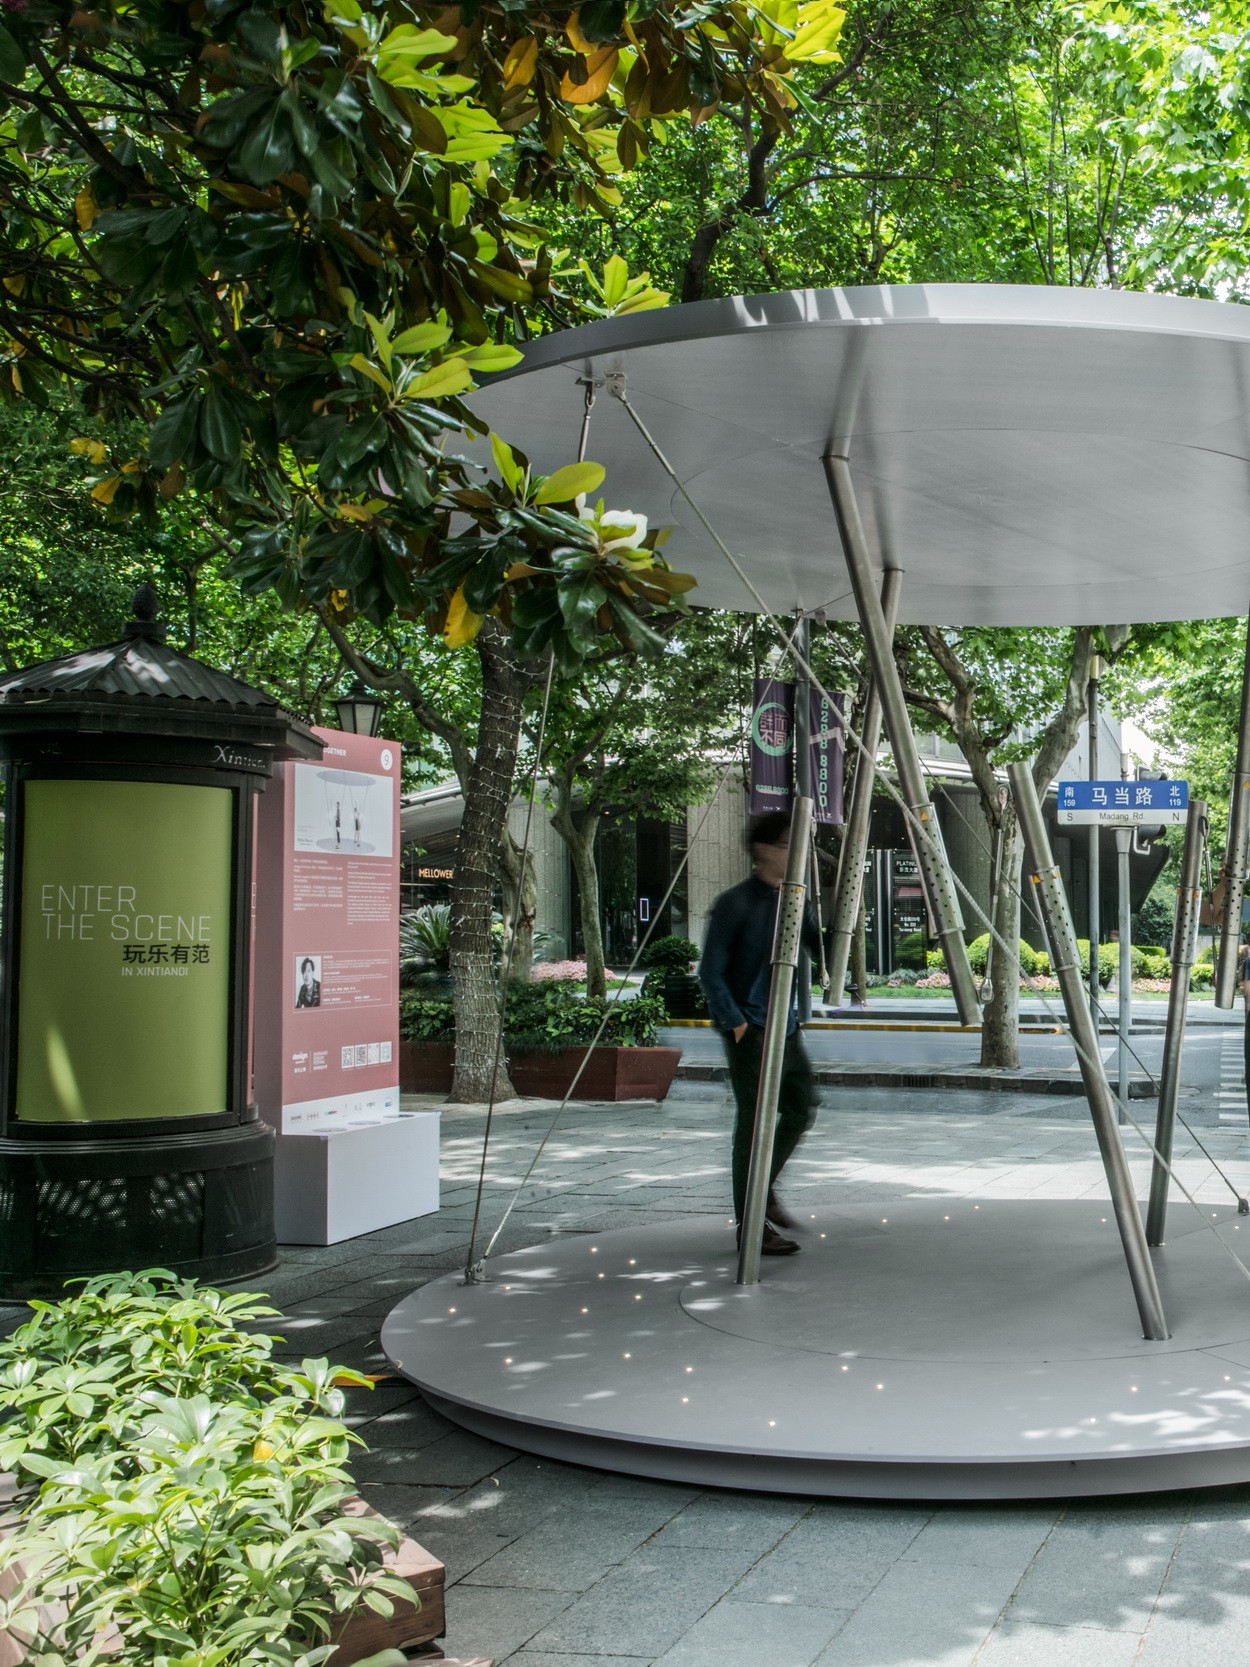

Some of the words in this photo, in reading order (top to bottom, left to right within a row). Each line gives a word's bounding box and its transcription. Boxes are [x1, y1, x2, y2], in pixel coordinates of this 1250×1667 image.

[760, 729, 788, 749] 不同
[323, 747, 347, 757] OGETHER
[1064, 786, 1075, 798] 南
[1091, 786, 1153, 806] 马当路
[1169, 785, 1181, 797] 北
[1063, 799, 1076, 807] 159
[1066, 812, 1074, 822] S
[1099, 812, 1130, 822] Madang
[1172, 812, 1180, 821] N
[418, 868, 454, 879] MELLOWER
[41, 884, 136, 912] ENTER
[42, 913, 95, 941] THE
[110, 914, 212, 942] SCENE
[122, 943, 211, 964] 玩乐有范
[121, 966, 133, 976] IN
[136, 966, 189, 977] XINTIANDI
